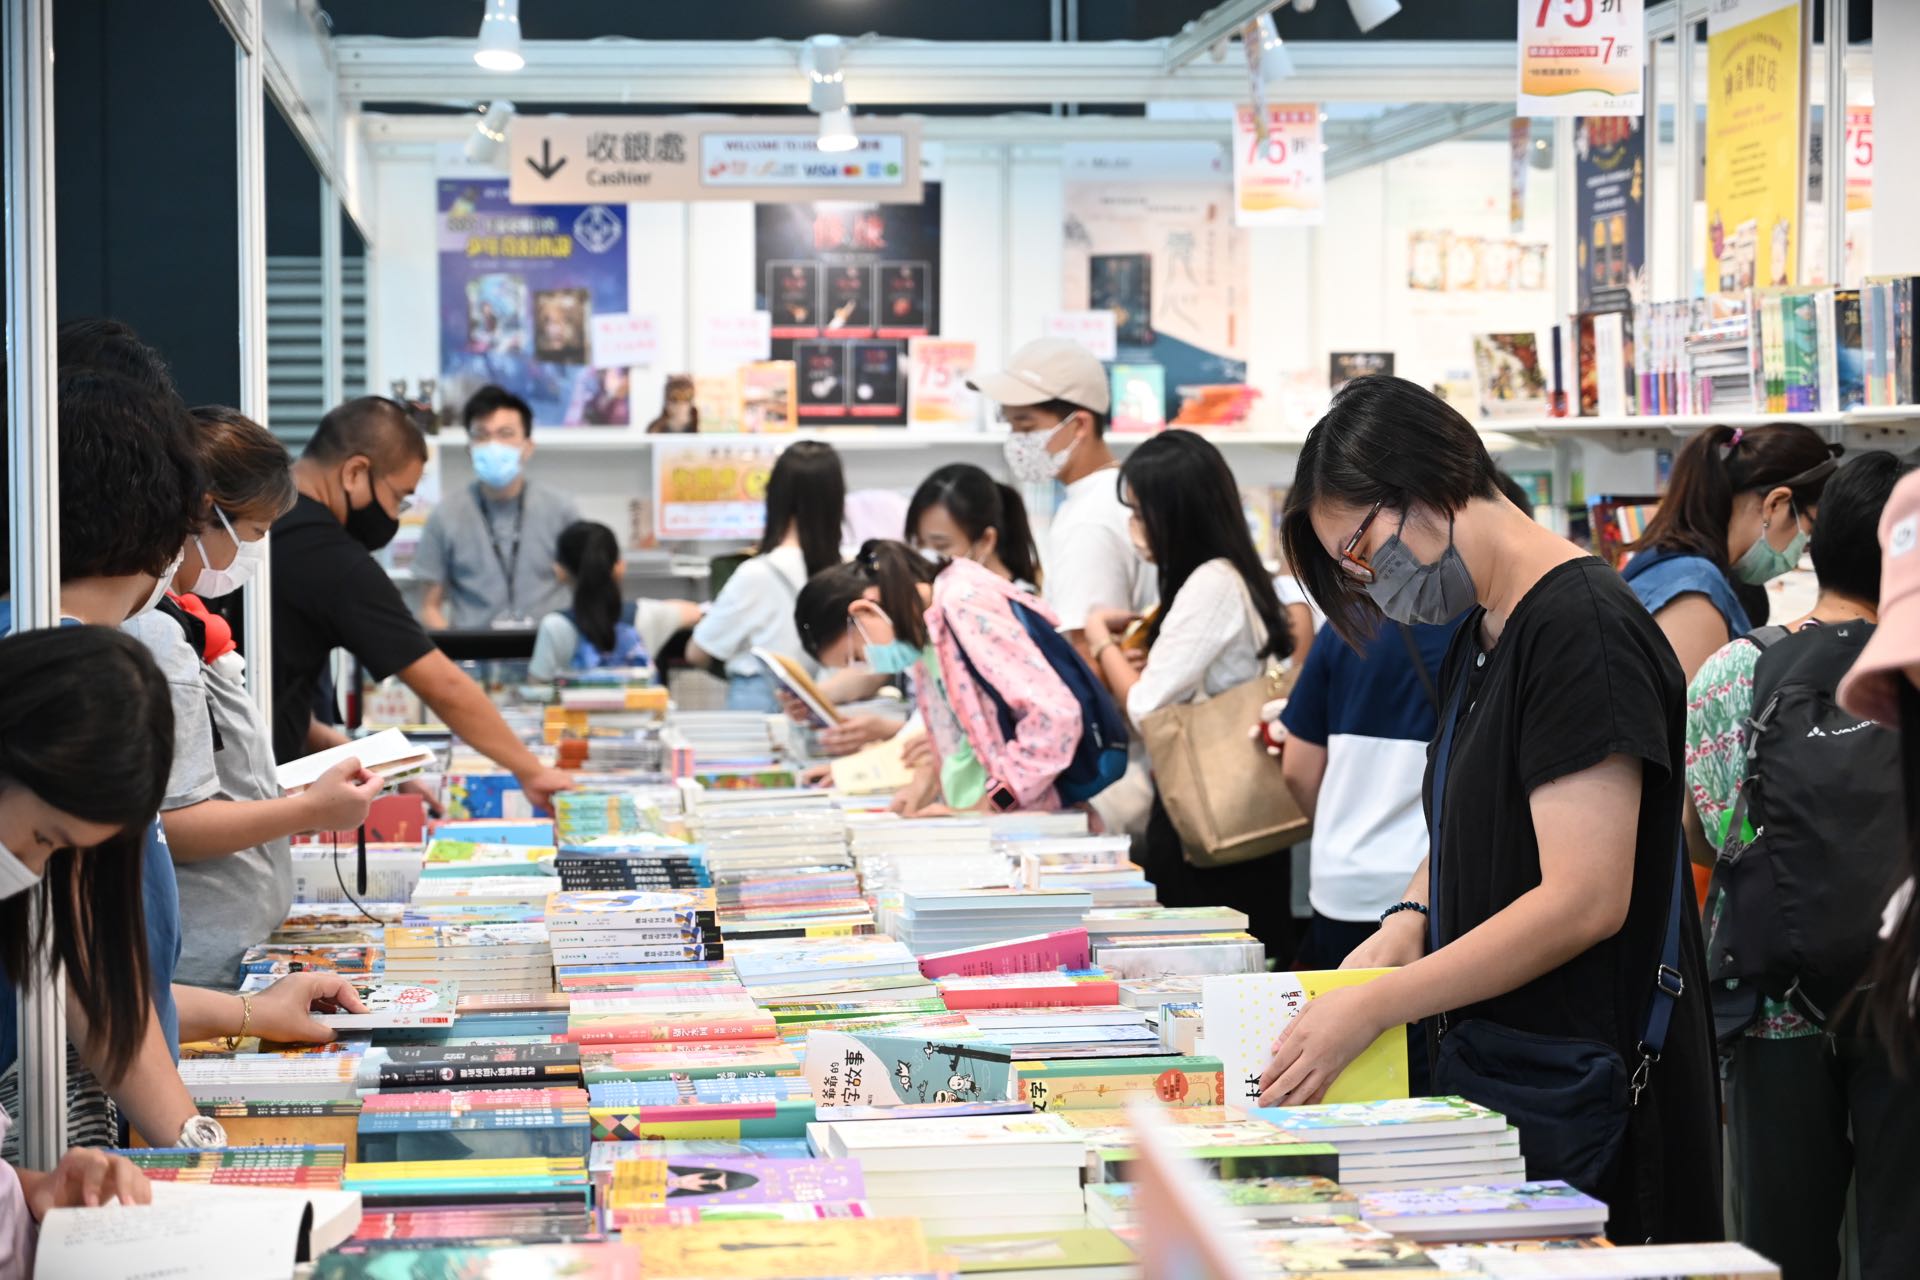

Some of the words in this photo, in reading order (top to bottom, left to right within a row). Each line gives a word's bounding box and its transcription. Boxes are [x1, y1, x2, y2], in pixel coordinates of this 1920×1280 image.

[587, 132, 687, 163] 收銀處
[587, 168, 651, 187] Cashier
[803, 165, 838, 177] VISA
[841, 1048, 865, 1107] 字故事
